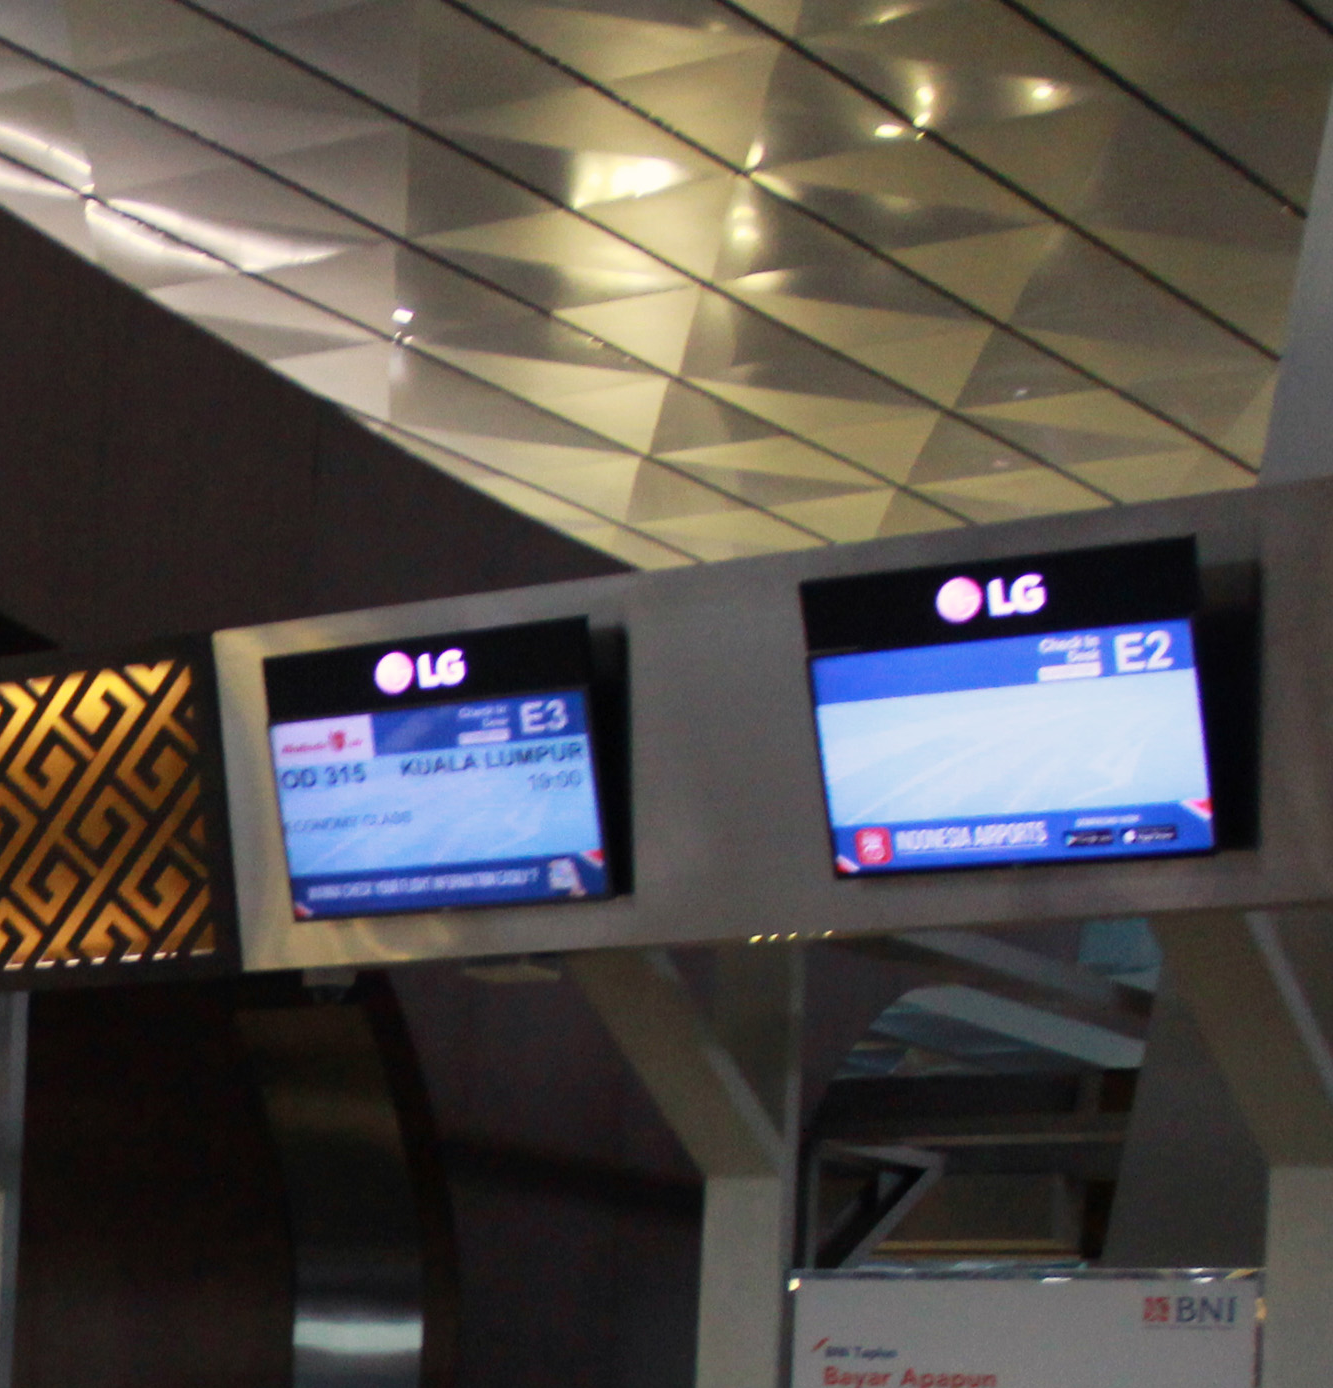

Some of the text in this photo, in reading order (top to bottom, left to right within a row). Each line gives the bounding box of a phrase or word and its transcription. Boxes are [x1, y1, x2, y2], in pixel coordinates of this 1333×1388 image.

[987, 573, 1046, 617] LG
[417, 648, 467, 689] LG
[1114, 630, 1174, 672] E2
[520, 699, 567, 734] E3
[282, 763, 367, 790] OD 315
[400, 742, 582, 777] KUALA LUMPUR
[974, 820, 1047, 847] AIRPORTS
[1175, 1296, 1238, 1324] BNI
